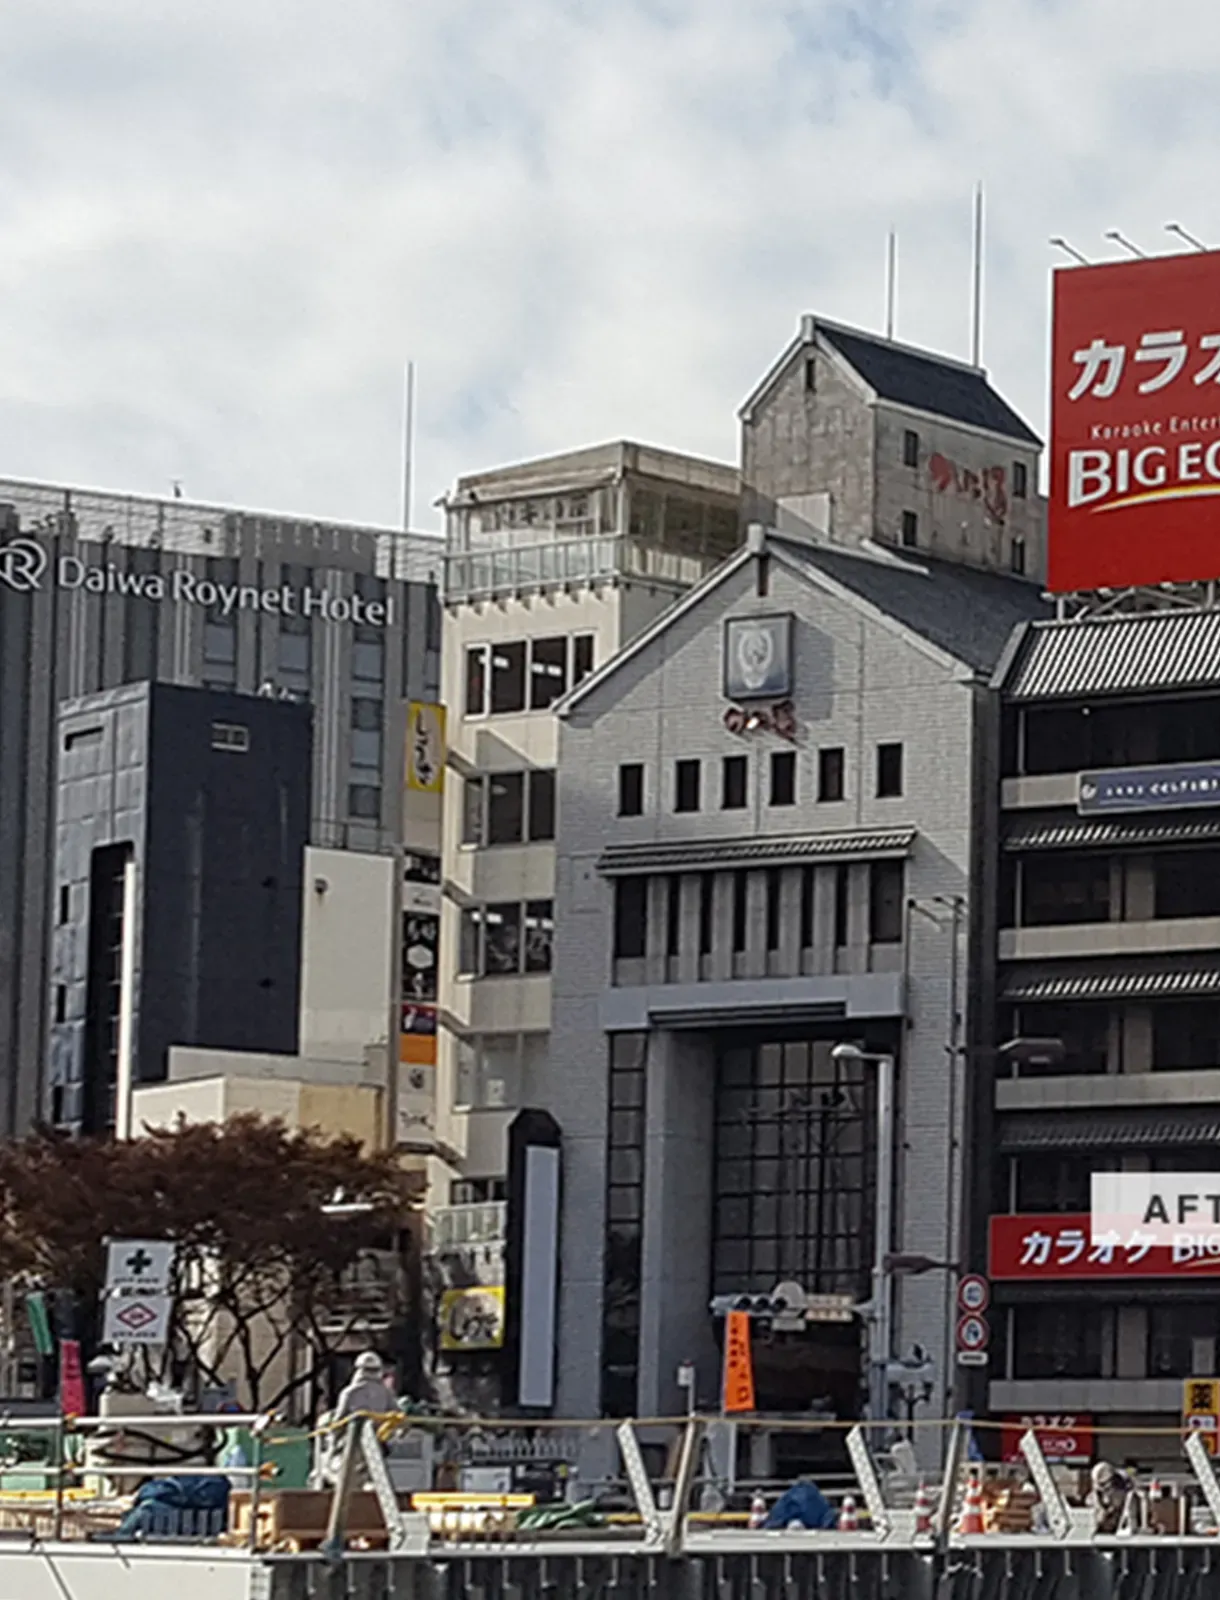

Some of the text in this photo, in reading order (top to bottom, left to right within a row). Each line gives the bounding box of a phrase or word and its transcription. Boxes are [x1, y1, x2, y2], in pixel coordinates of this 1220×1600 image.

[1091, 420, 1161, 440] Karaoke
[1068, 446, 1167, 508] BIG
[58, 555, 394, 627] Daiwa Roynet Hotel
[1020, 1229, 1155, 1265] カラオケ
